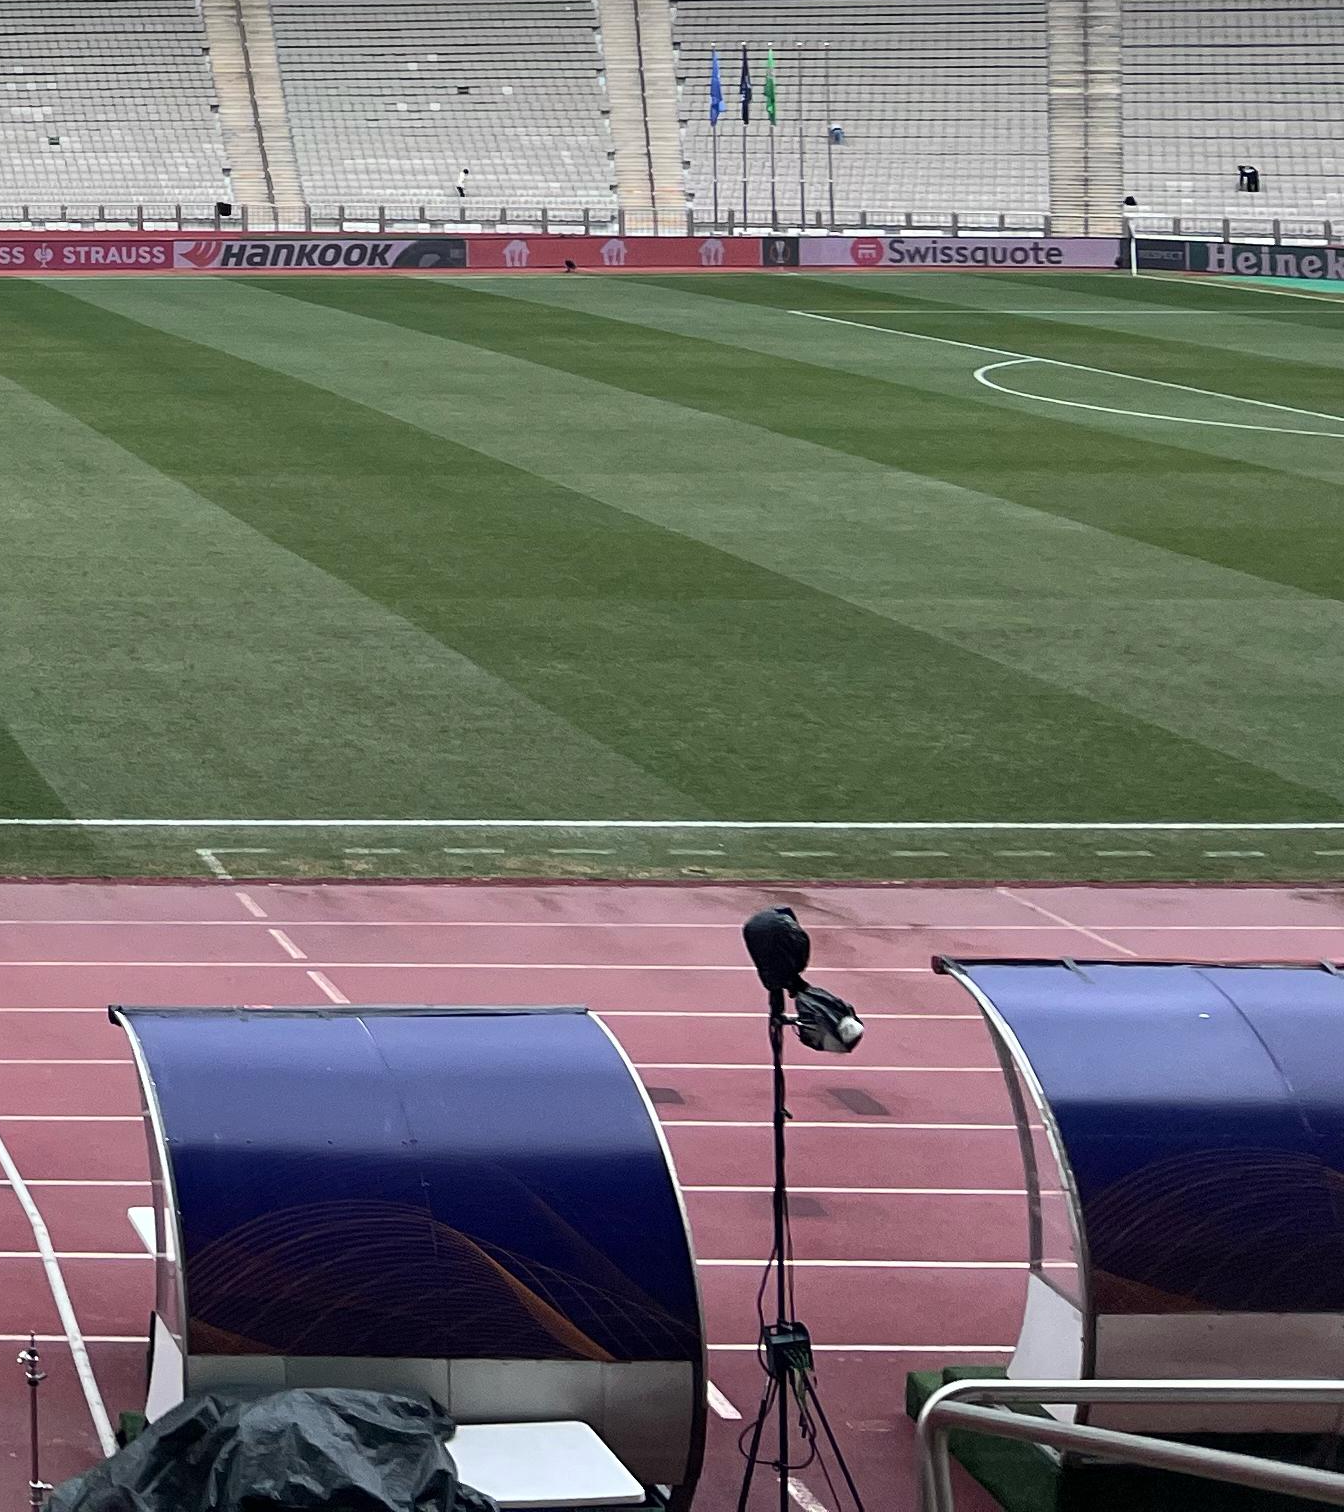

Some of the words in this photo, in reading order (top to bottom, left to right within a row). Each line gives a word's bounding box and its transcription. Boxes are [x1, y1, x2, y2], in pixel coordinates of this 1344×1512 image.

[63, 246, 166, 264] STRAUSS
[888, 238, 1063, 266] Swissquote
[1206, 242, 1344, 279] Heinek
